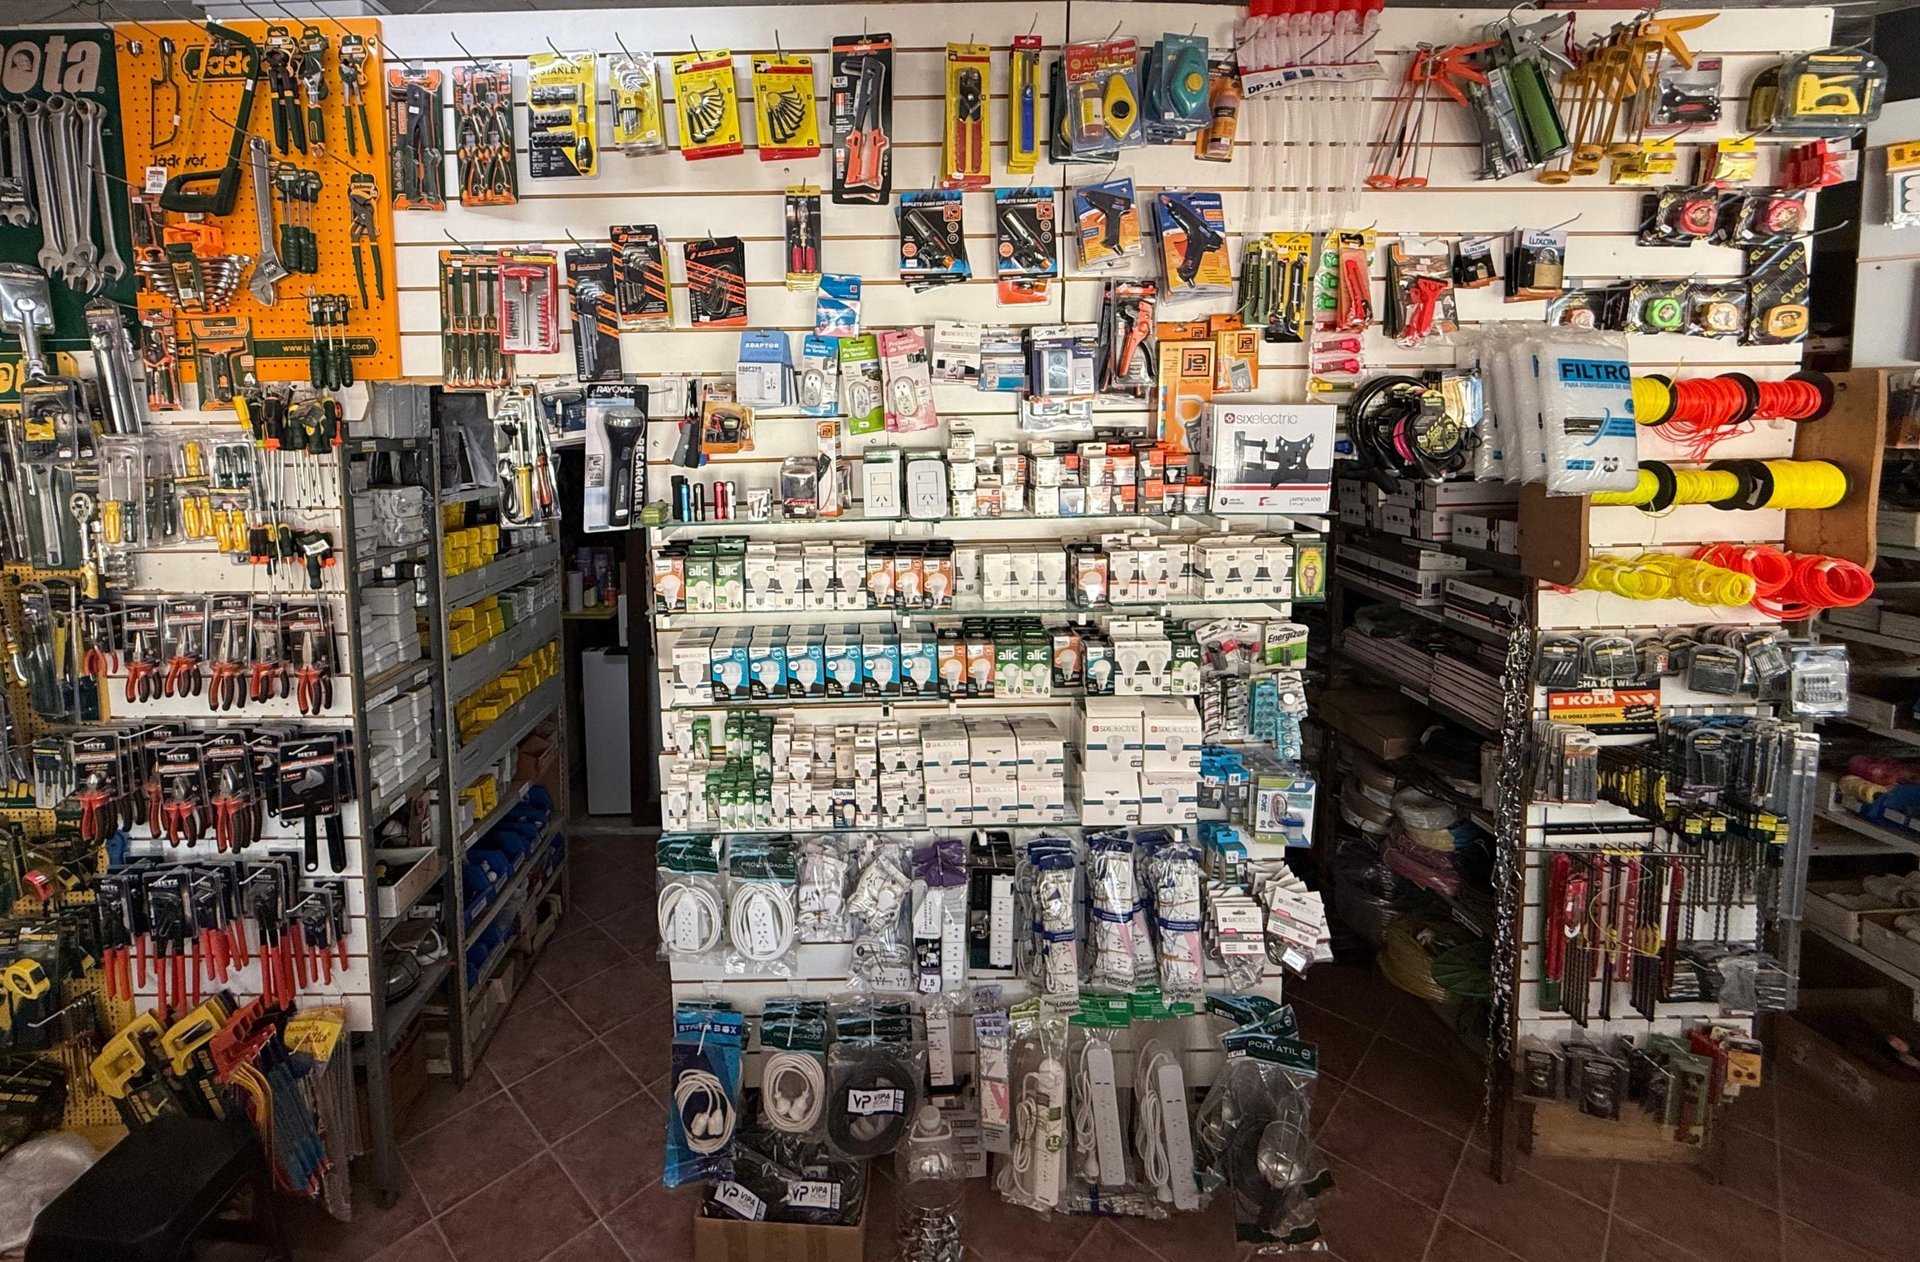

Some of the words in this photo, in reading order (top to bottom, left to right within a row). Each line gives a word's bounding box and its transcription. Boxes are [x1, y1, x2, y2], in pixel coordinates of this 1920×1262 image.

[0, 35, 101, 93] ota
[1247, 80, 1283, 95] DP-14
[1561, 363, 1631, 380] FILTRO
[596, 385, 635, 394] RAYOVAC
[1236, 412, 1298, 425] sixelectric
[633, 437, 645, 512] RECARGABLE
[688, 565, 709, 576] alic
[718, 565, 738, 576] alic
[130, 611, 150, 619] METZ
[298, 611, 318, 619] METZ
[998, 651, 1019, 661] alic
[1026, 651, 1048, 661] alic
[1176, 645, 1199, 659] alic
[1578, 680, 1598, 689] CHA
[83, 741, 106, 750] METZ
[166, 753, 190, 761] METZ
[1248, 1040, 1299, 1056] PORTATIL
[853, 1094, 872, 1109] VP
[873, 1093, 891, 1101] VIPA
[811, 1185, 828, 1194] VIPA
